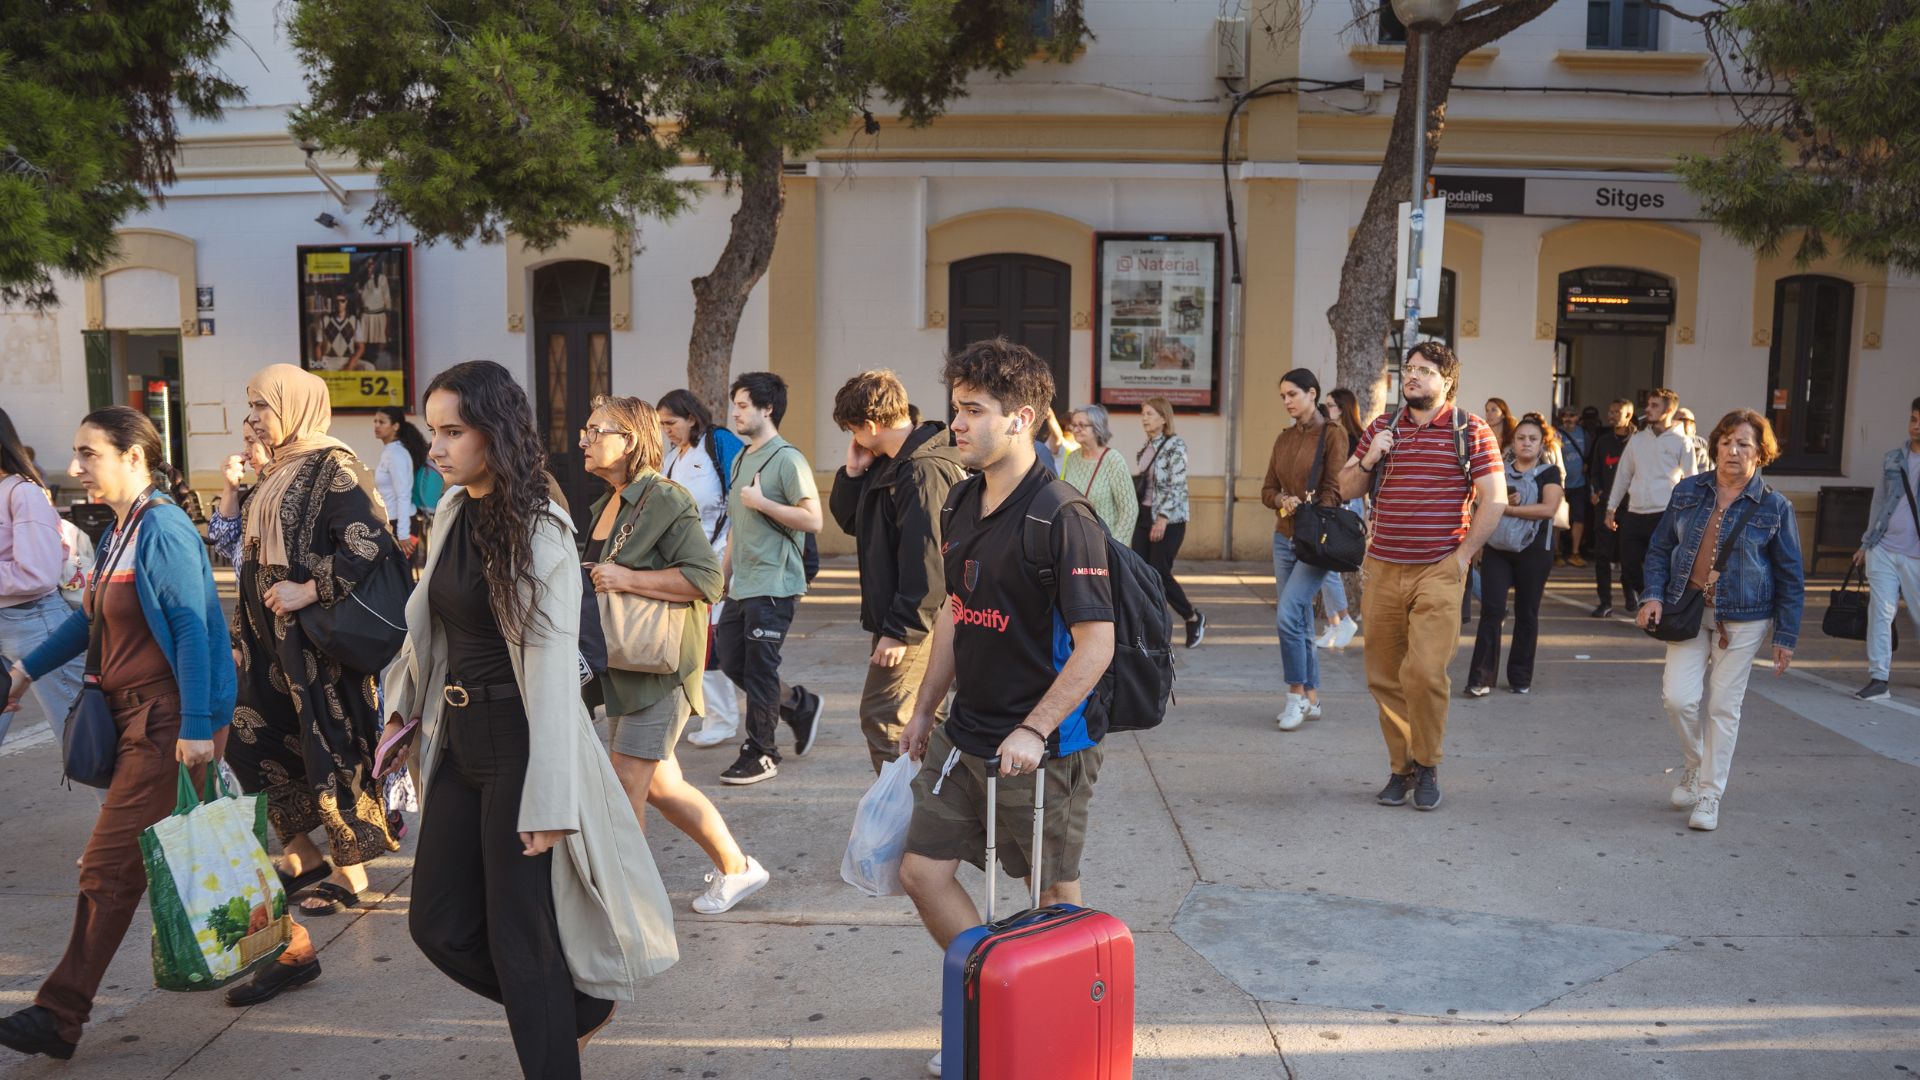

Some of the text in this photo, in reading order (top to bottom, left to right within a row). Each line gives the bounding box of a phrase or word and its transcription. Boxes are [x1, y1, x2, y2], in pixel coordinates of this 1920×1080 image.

[1596, 187, 1665, 212] Sitges
[1137, 256, 1200, 272] Naterial
[360, 376, 389, 396] 52
